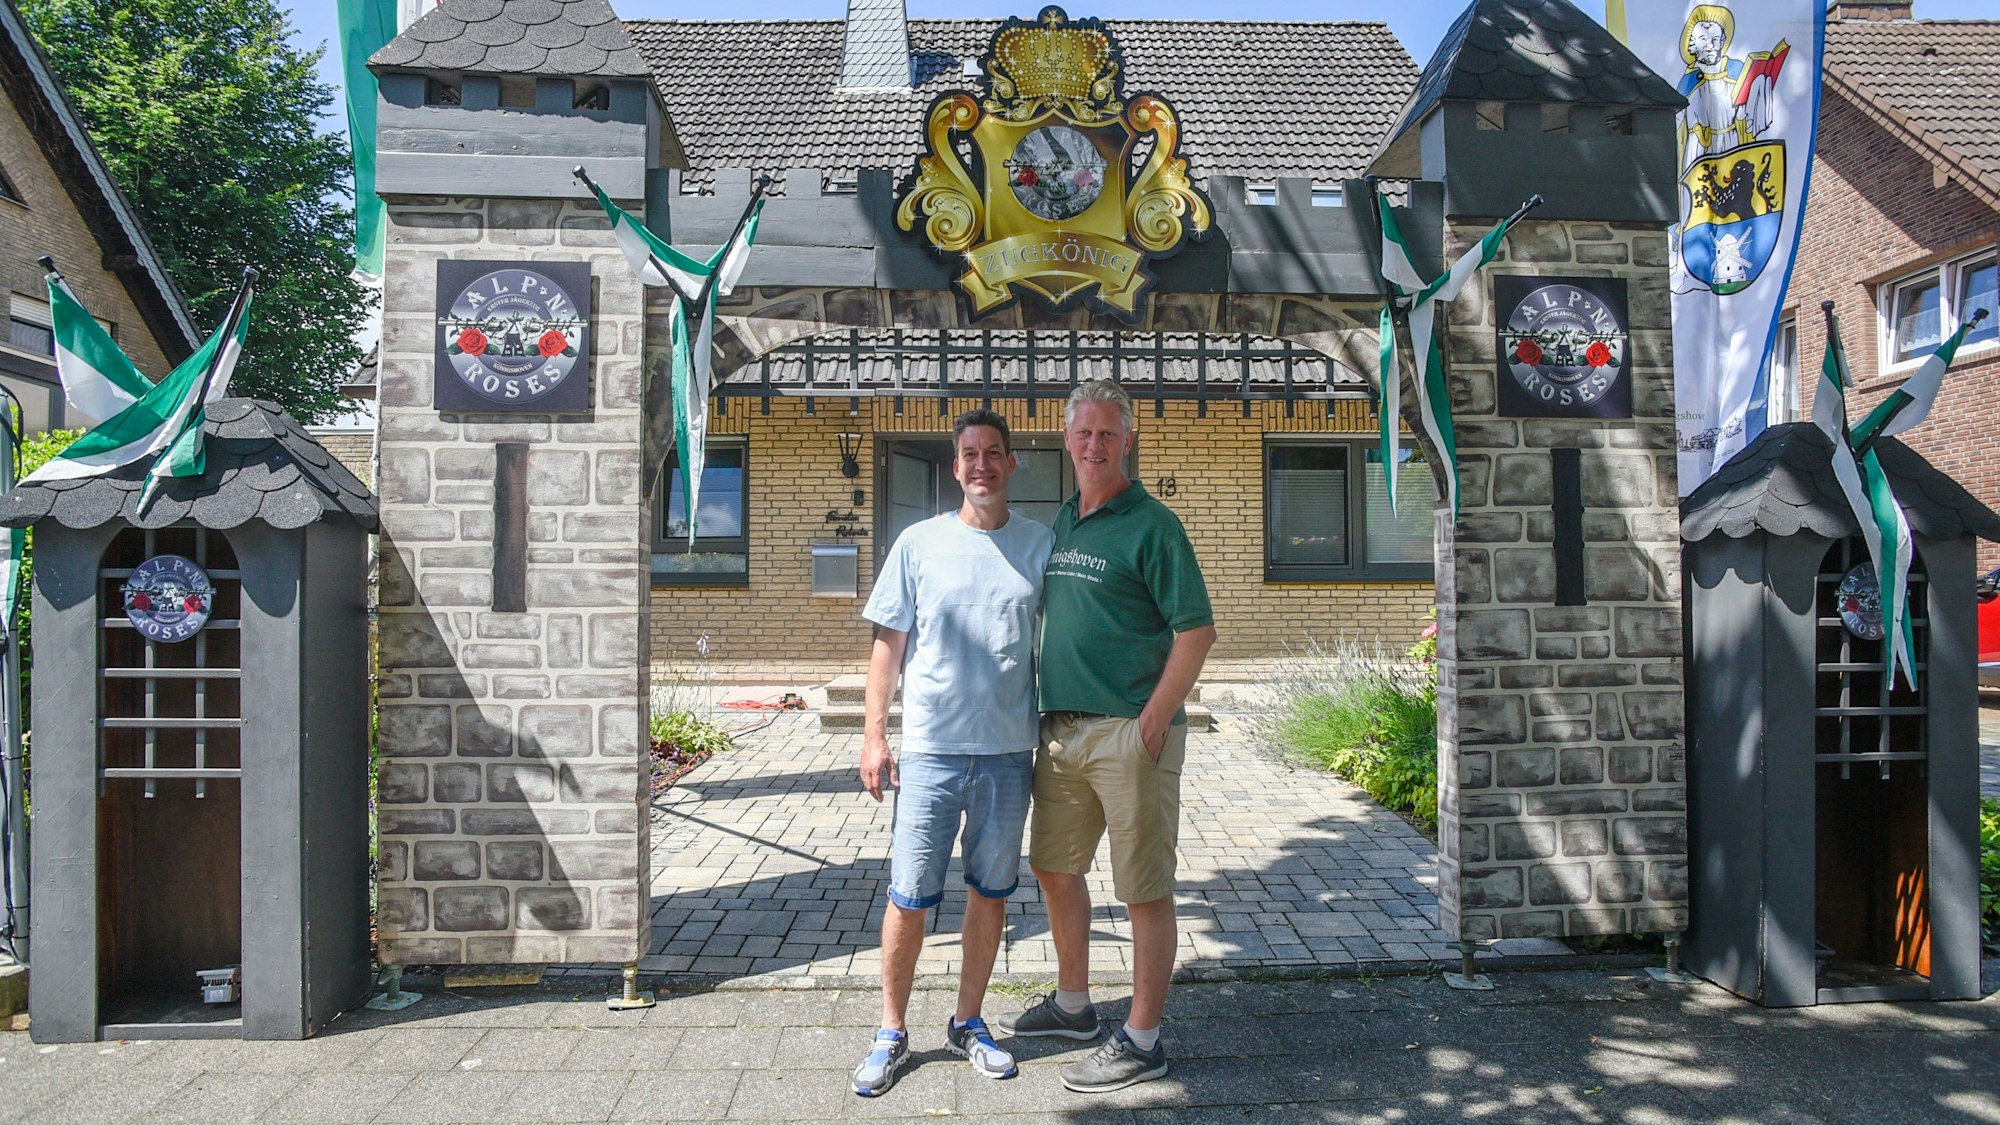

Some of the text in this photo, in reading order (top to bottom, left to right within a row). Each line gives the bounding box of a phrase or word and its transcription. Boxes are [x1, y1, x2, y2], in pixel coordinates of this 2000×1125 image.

[980, 238, 1131, 275] ZUGKÖNIG
[487, 296, 541, 312] ERSTER JÄGERZUG
[492, 362, 533, 374] KÖNIGSHOVEN
[464, 362, 562, 399] ROSES
[1523, 373, 1607, 405] ROSES
[1157, 478, 1176, 497] 13
[136, 617, 198, 639] ROSES
